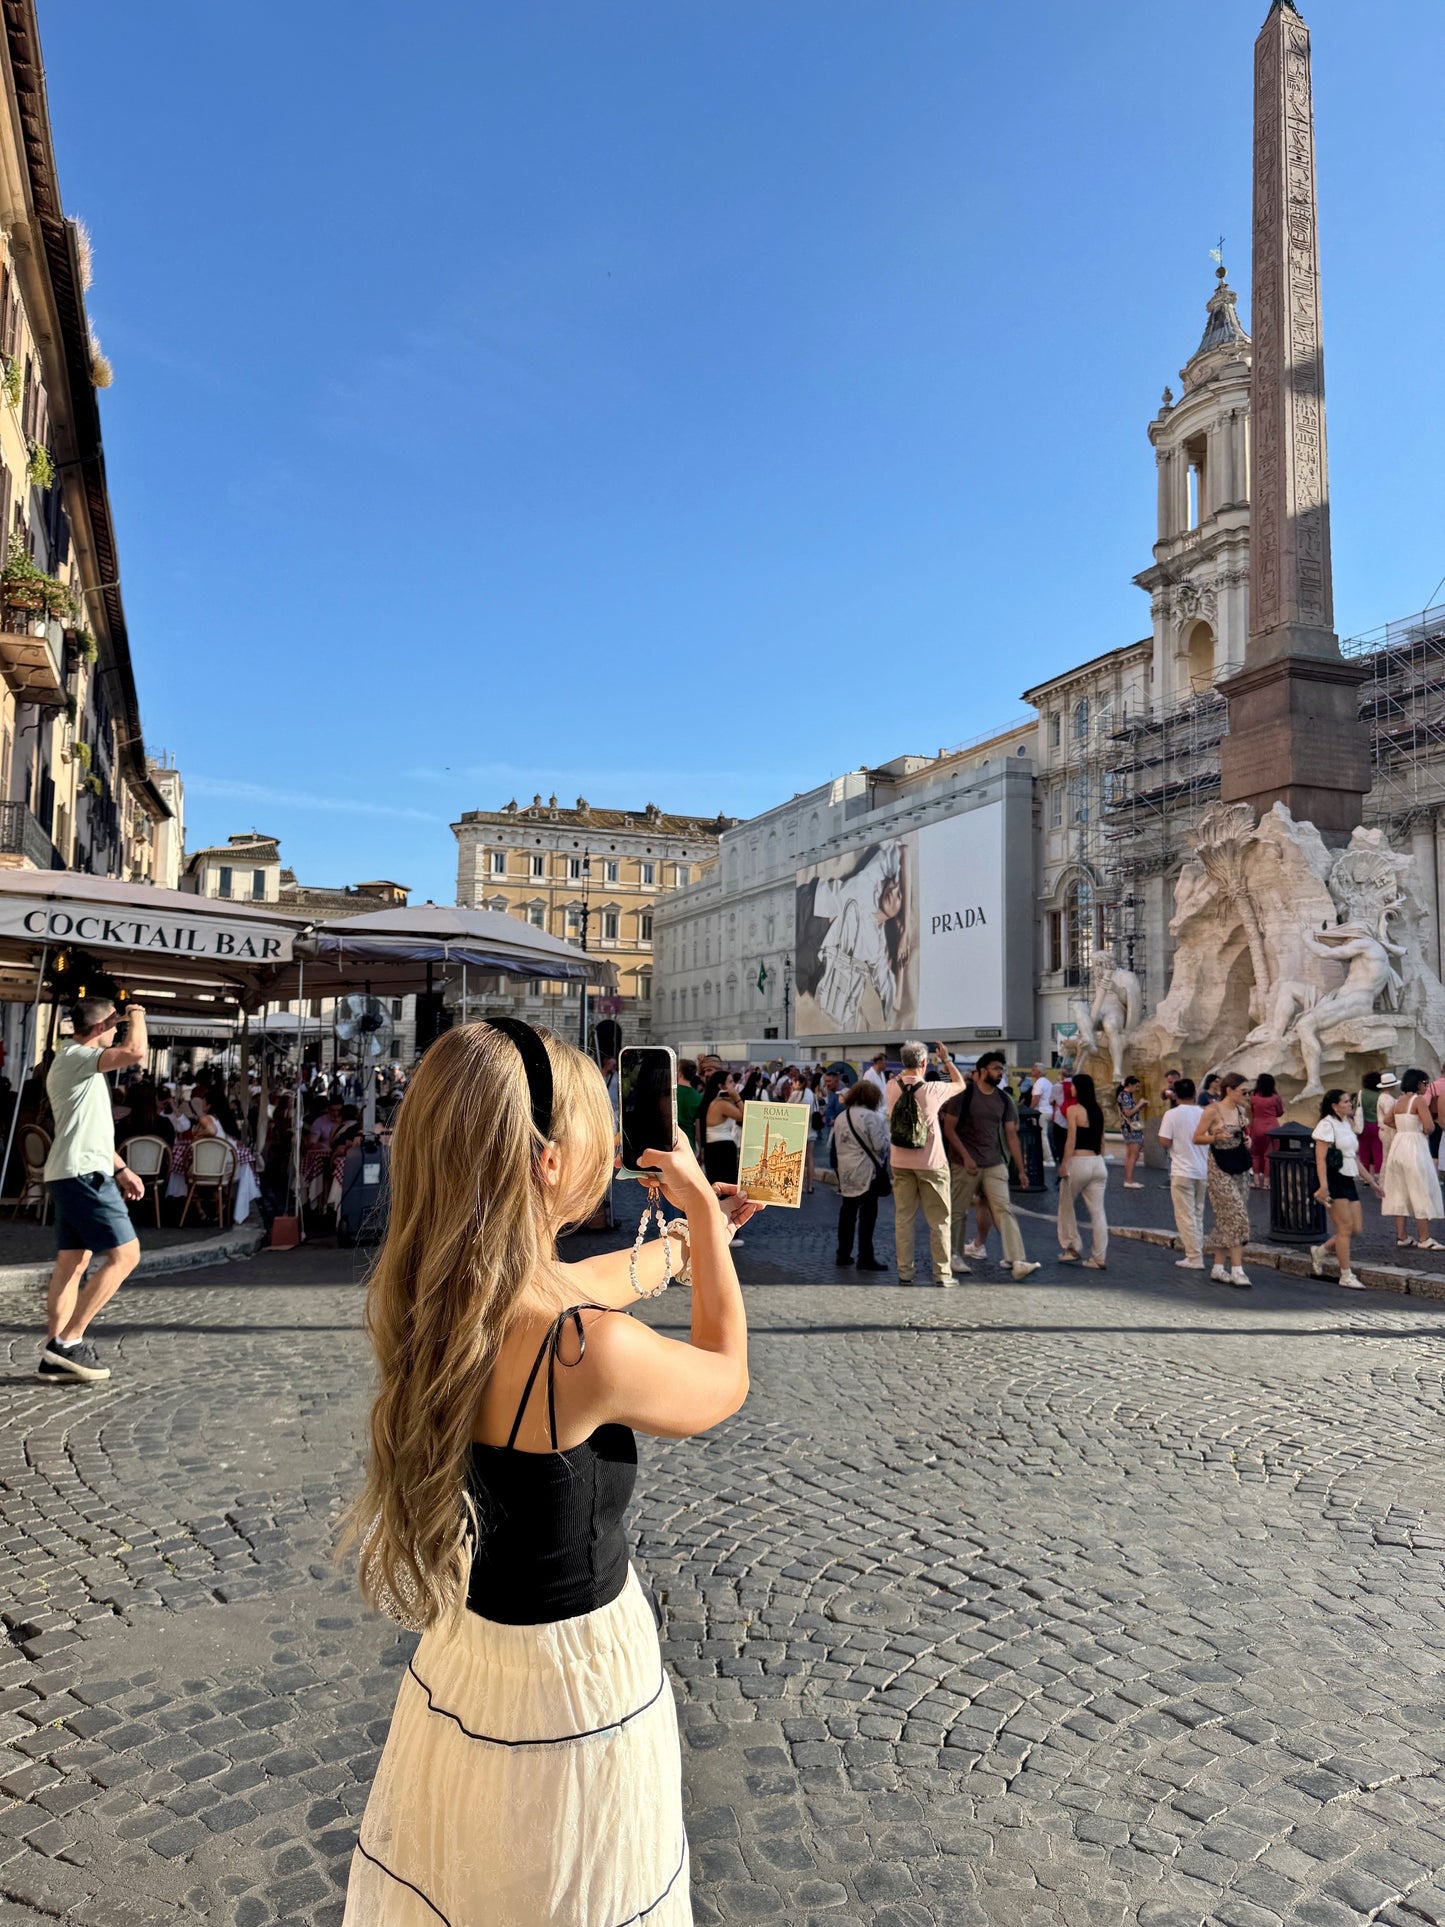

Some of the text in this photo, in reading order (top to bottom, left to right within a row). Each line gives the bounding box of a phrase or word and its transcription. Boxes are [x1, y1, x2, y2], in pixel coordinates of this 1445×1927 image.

[932, 906, 986, 935] PRADA
[23, 910, 282, 958] COCKTAIL BAR
[157, 1026, 186, 1035] WINE
[763, 1107, 789, 1116] ROMA
